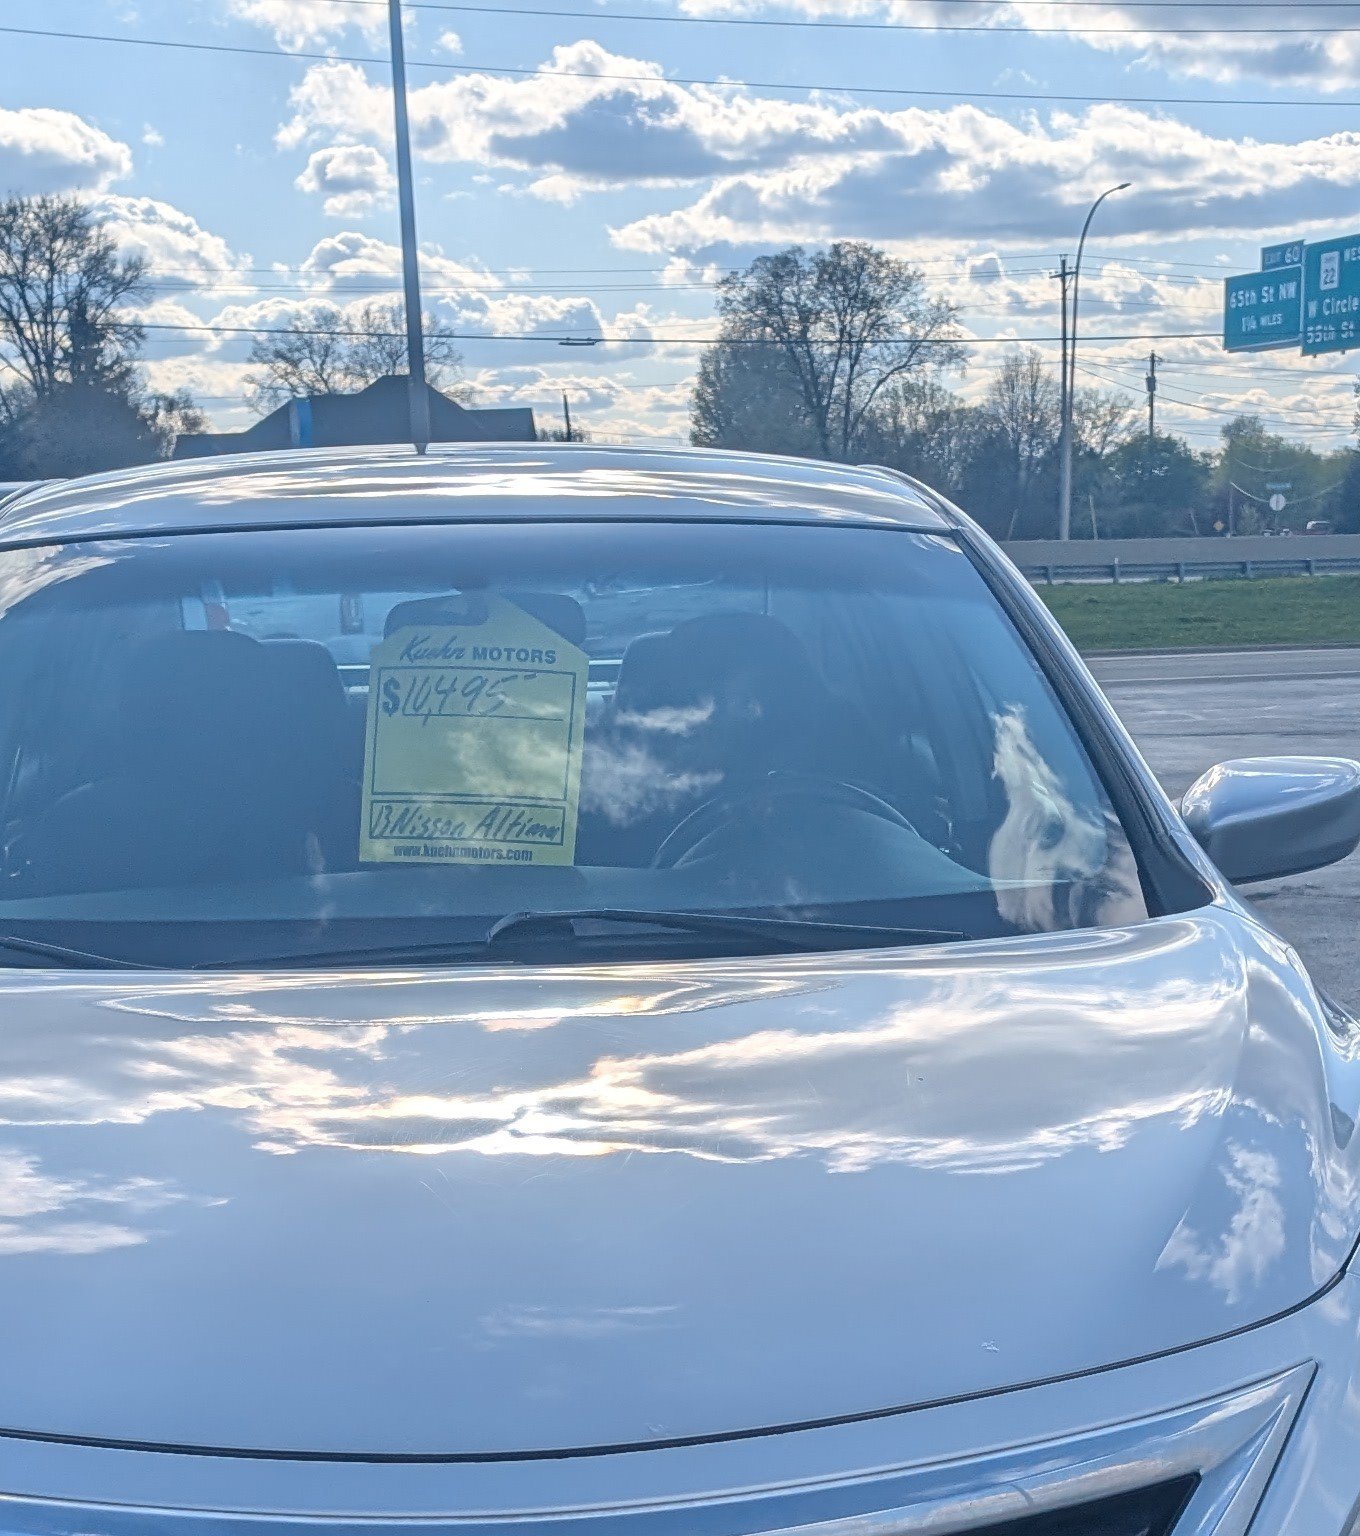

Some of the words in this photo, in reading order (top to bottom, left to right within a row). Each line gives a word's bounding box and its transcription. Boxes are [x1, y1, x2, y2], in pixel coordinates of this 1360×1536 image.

[1284, 245, 1300, 264] 60
[1323, 267, 1336, 285] 22
[1229, 289, 1257, 309] 65th
[1261, 286, 1274, 304] St
[1279, 281, 1297, 300] NW
[1308, 299, 1318, 318] W
[1323, 292, 1360, 316] Circle
[1306, 325, 1337, 344] 55th
[1341, 323, 1355, 338] St
[472, 646, 557, 665] MOTORS
